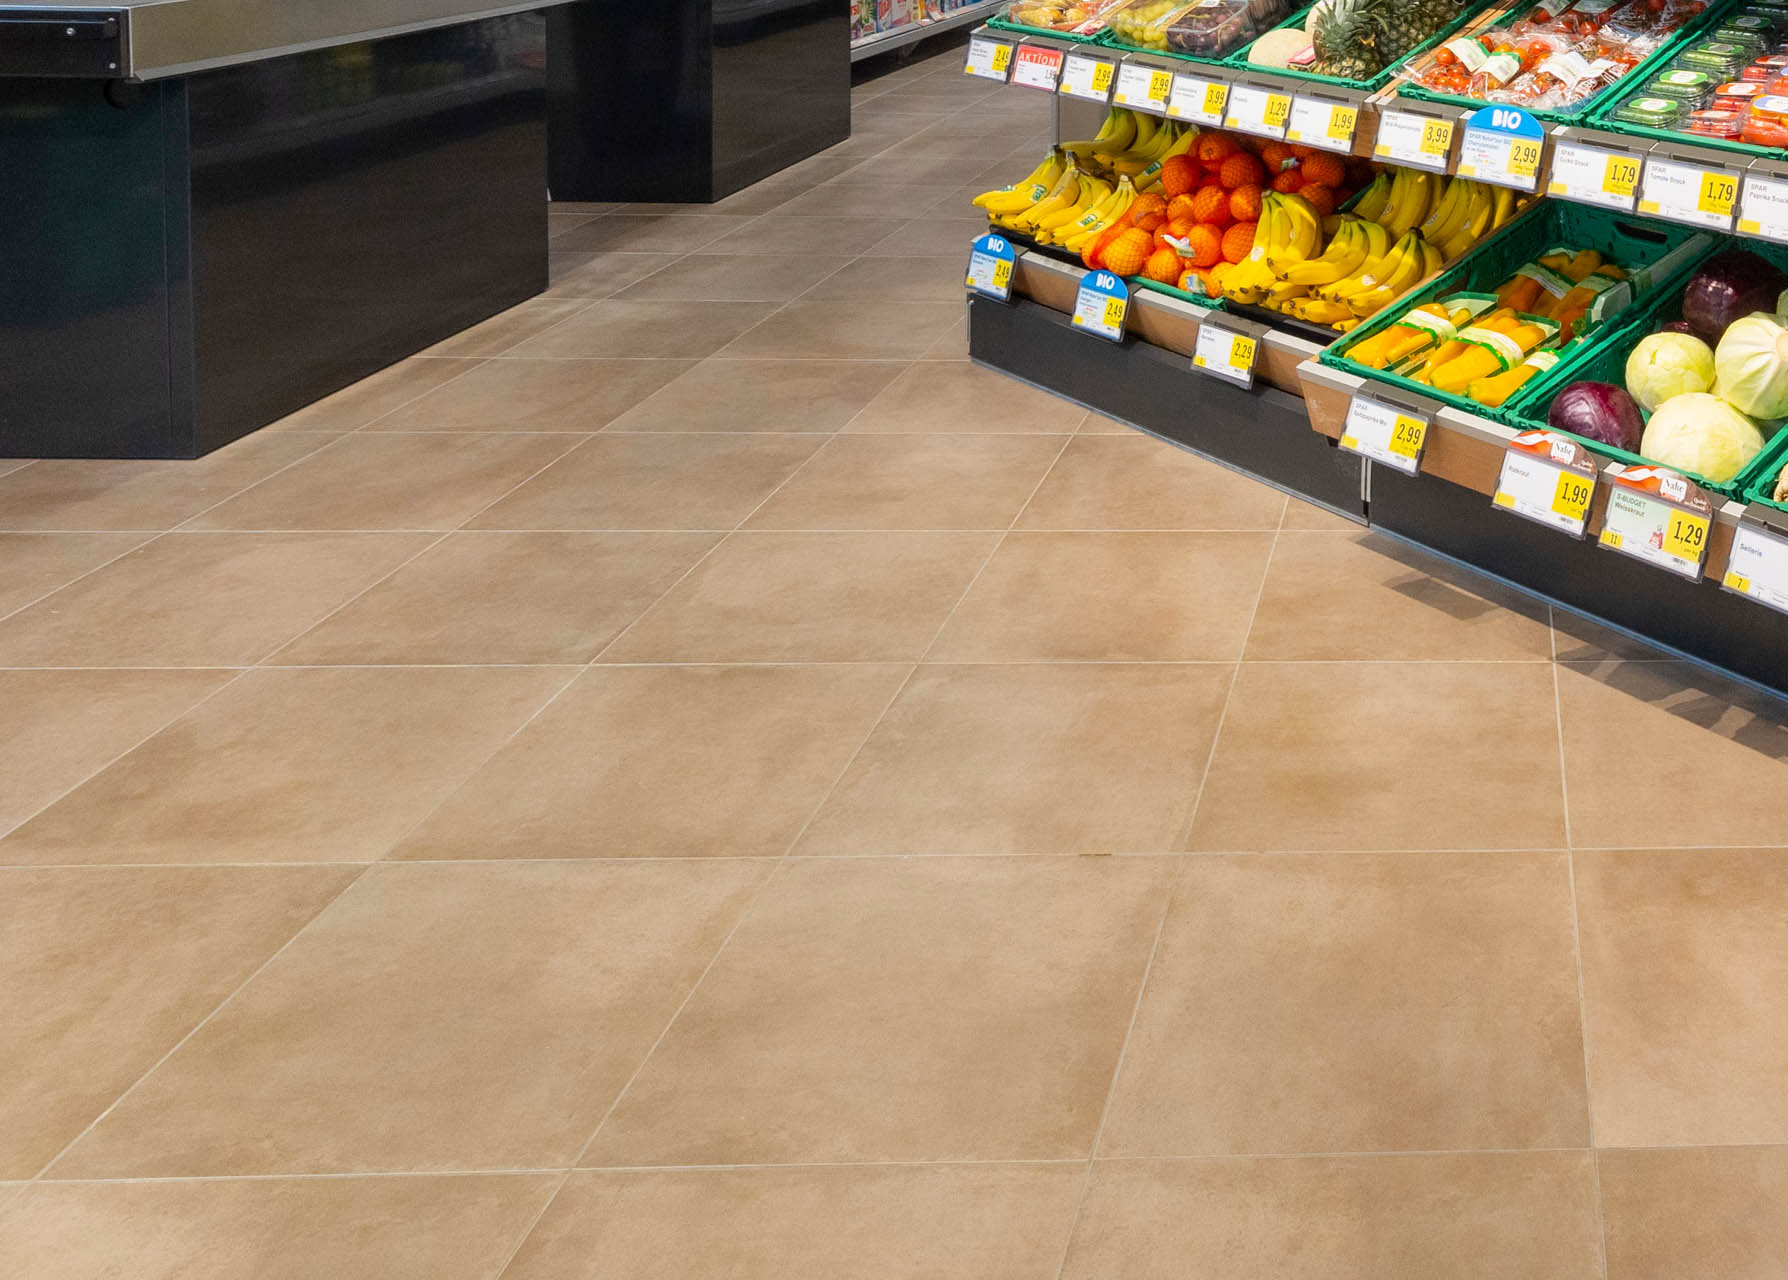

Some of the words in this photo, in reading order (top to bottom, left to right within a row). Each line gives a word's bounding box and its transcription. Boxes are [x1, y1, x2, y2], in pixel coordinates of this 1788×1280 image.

[1019, 52, 1060, 67] AKTION!
[1492, 110, 1521, 129] BIO
[1426, 126, 1447, 144] 3,99
[1513, 146, 1537, 165] 2,99
[1611, 164, 1636, 183] 1,79
[1708, 182, 1733, 201] 1,79
[988, 238, 1004, 252] BIO
[1096, 274, 1114, 290] BIO
[1397, 424, 1421, 445] 2,99
[1562, 483, 1588, 506] 1,99
[1616, 493, 1646, 508] S-BUDGET
[1614, 501, 1645, 517] Weisskraut
[1673, 520, 1703, 546] 1,29
[1740, 543, 1762, 556] Sellerie
